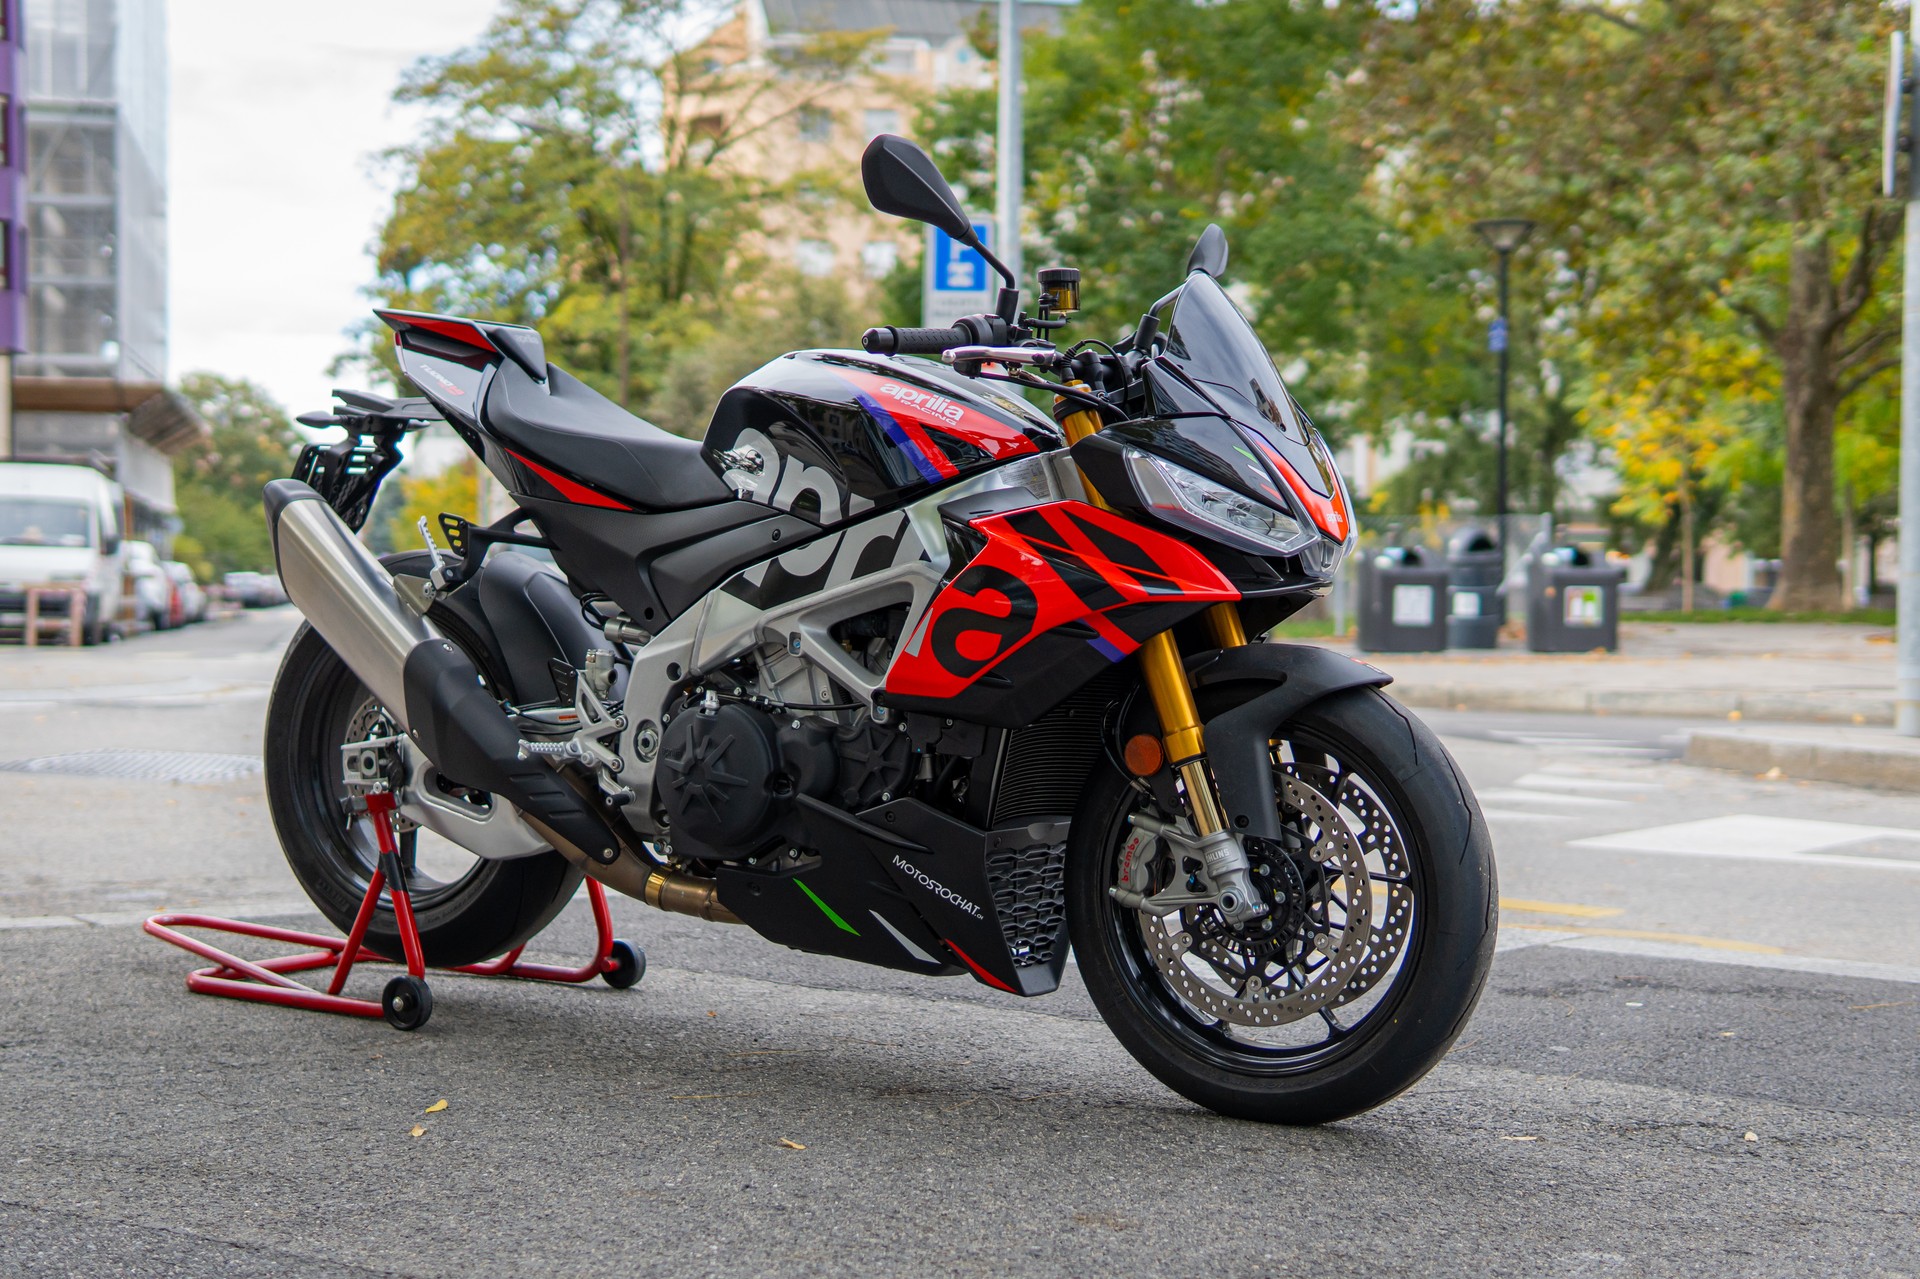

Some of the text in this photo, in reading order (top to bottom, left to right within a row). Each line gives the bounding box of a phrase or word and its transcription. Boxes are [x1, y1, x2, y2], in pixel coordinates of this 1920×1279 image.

[880, 383, 965, 420] aprilia
[900, 399, 957, 426] RACING
[1121, 836, 1140, 883] brembo
